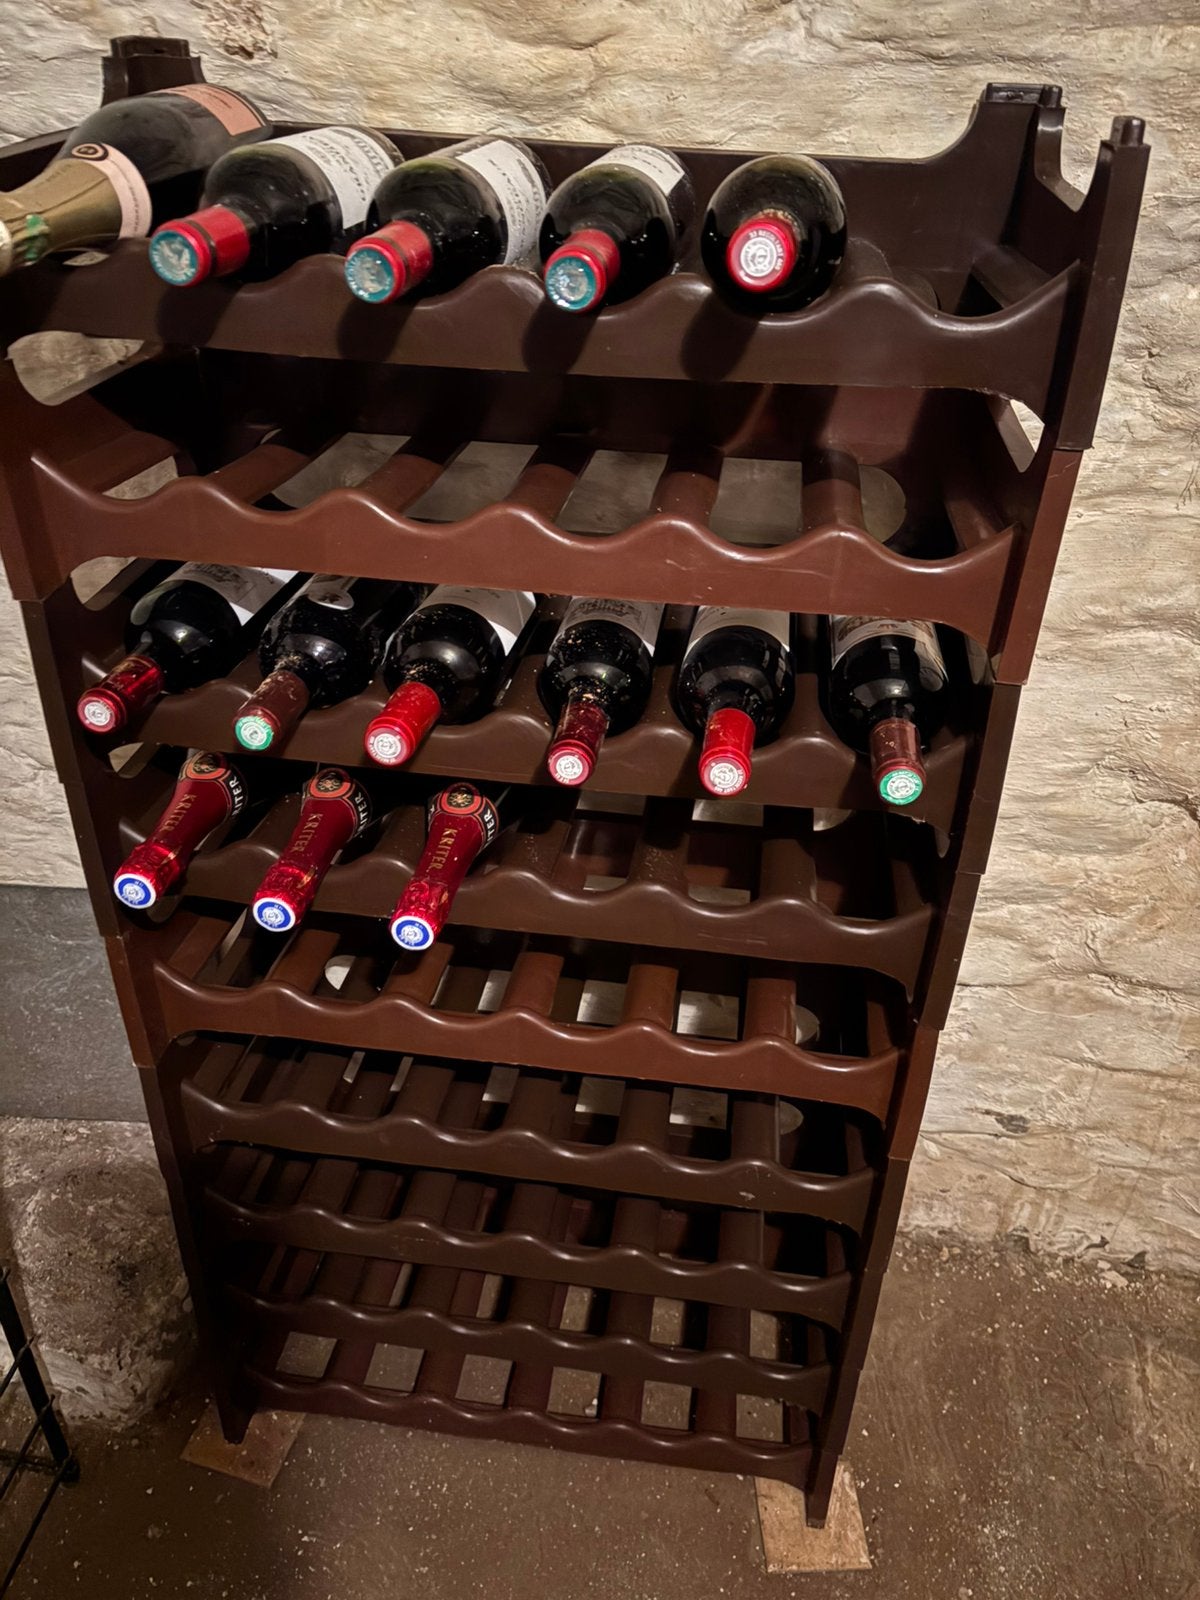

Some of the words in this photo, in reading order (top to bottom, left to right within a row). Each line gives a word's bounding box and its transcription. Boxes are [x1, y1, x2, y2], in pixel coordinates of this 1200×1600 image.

[159, 793, 199, 832] KRITER
[289, 812, 325, 853] KRITER
[429, 827, 458, 871] KRITER
